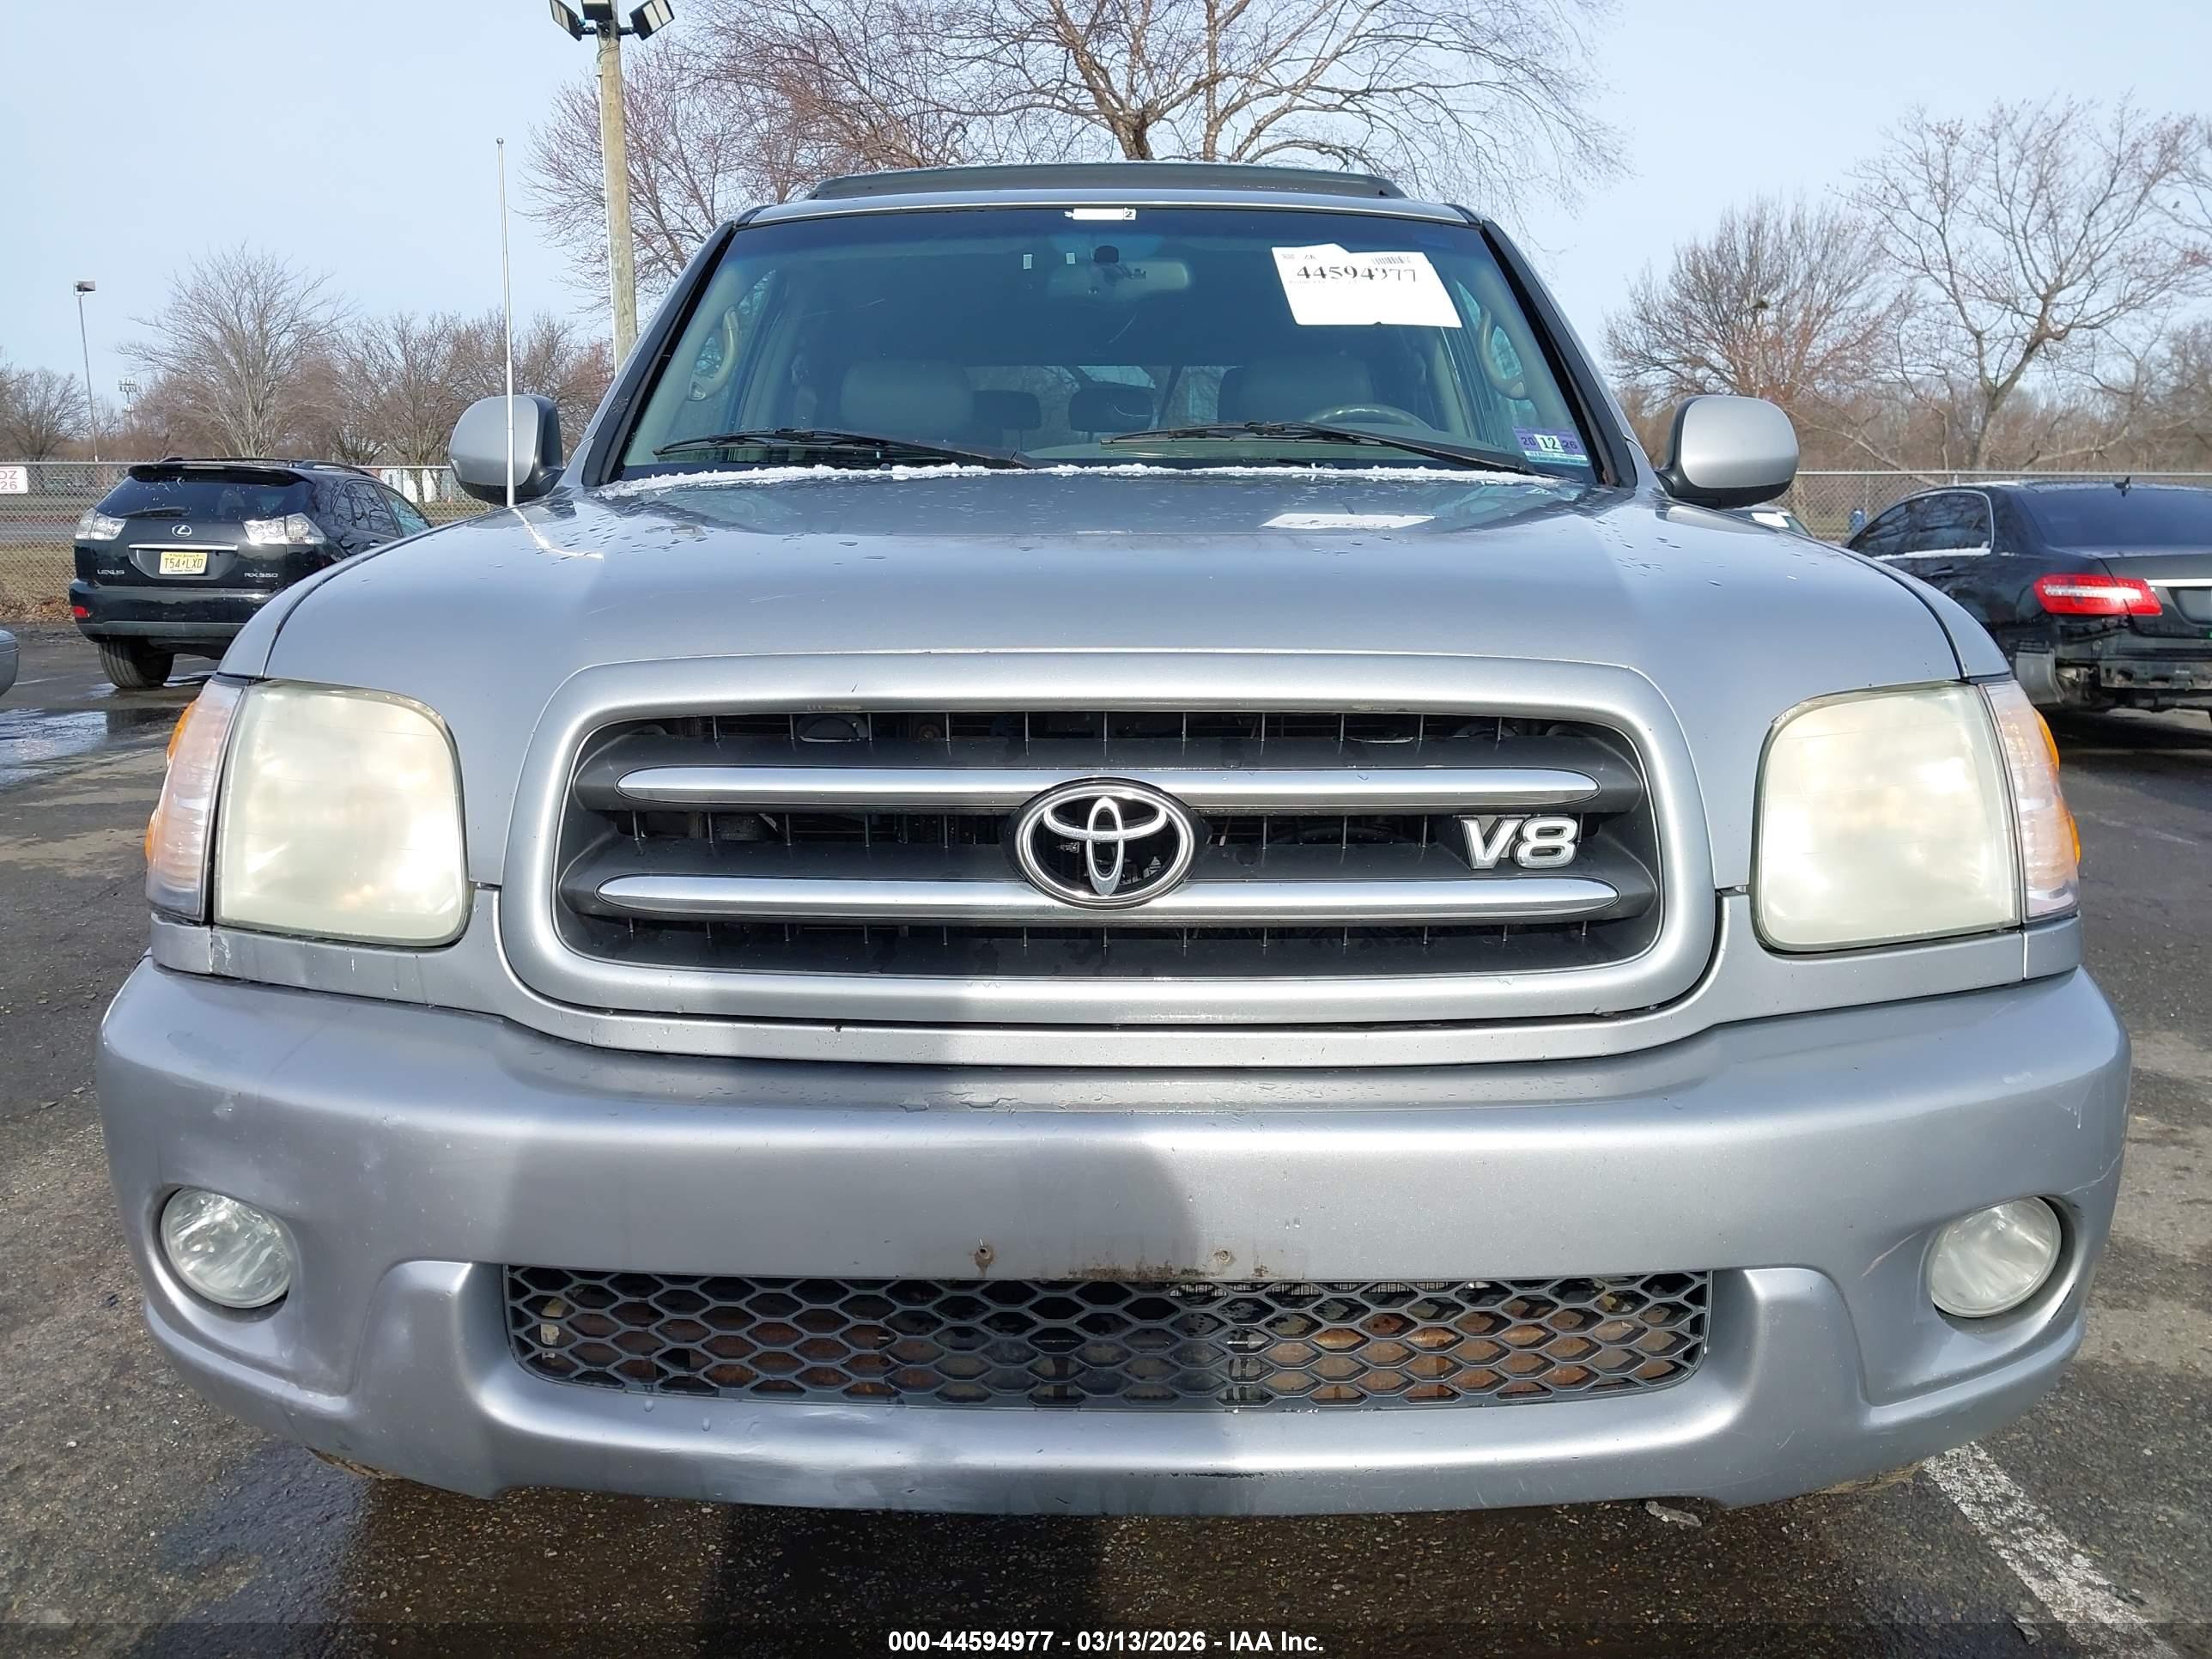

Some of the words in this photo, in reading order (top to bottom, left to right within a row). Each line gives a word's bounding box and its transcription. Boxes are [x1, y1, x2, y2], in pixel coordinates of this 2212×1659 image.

[1521, 436, 1536, 446] 20
[1539, 437, 1560, 450] 12
[1460, 816, 1578, 870] V8
